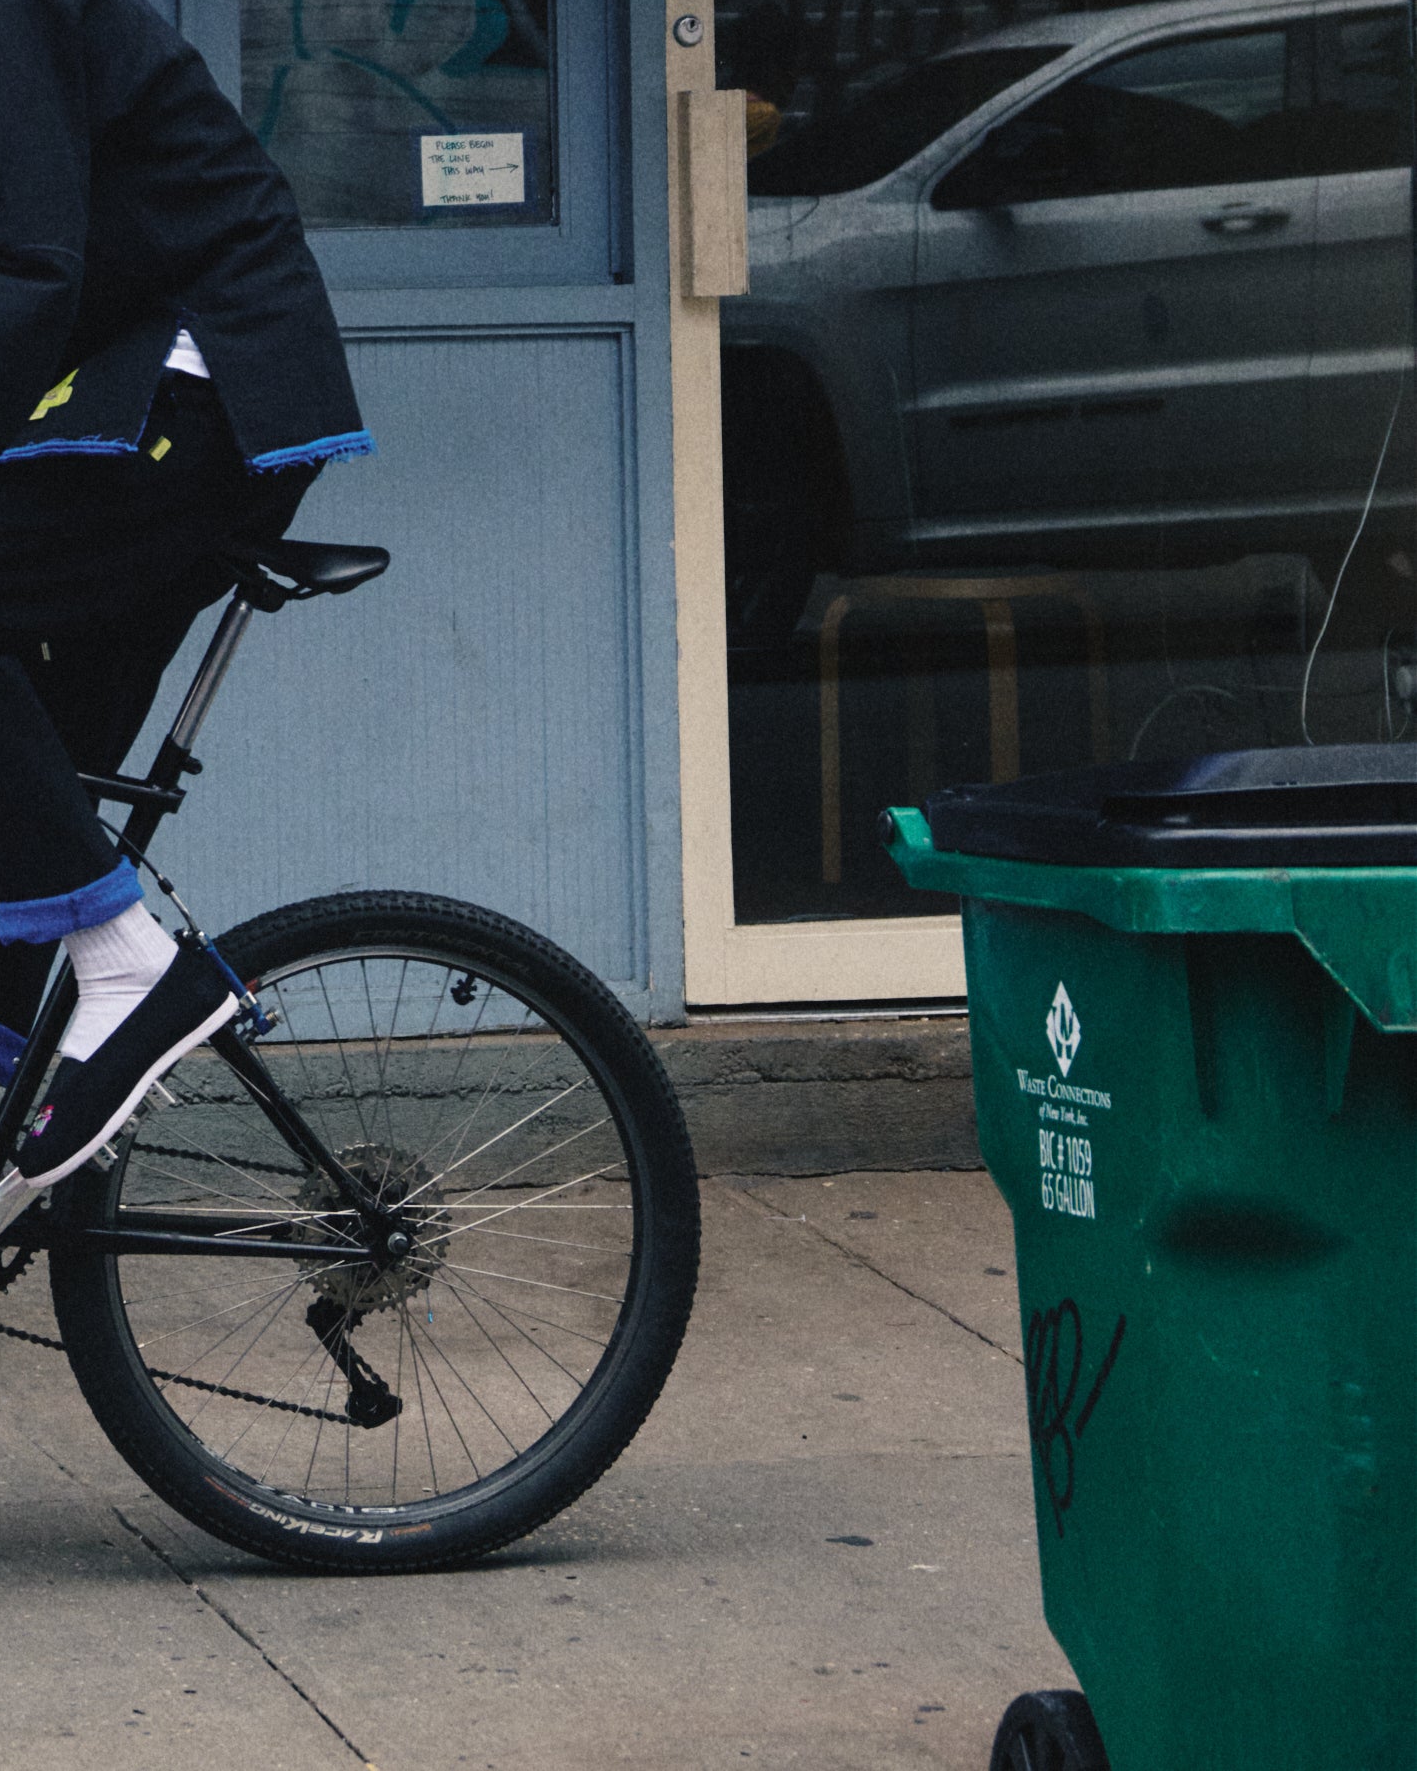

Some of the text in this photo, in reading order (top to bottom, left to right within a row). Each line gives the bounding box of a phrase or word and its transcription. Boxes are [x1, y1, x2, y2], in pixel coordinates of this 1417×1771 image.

[435, 139, 494, 151] PLEASE BEGIN
[428, 154, 471, 163] THE LINE
[441, 165, 485, 176] THIS WAY
[440, 194, 470, 204] THANK
[1046, 1103, 1059, 1120] New
[1039, 1129, 1056, 1170] BIC
[1066, 1136, 1093, 1177] 1059
[1041, 1172, 1095, 1220] 65 GALLON
